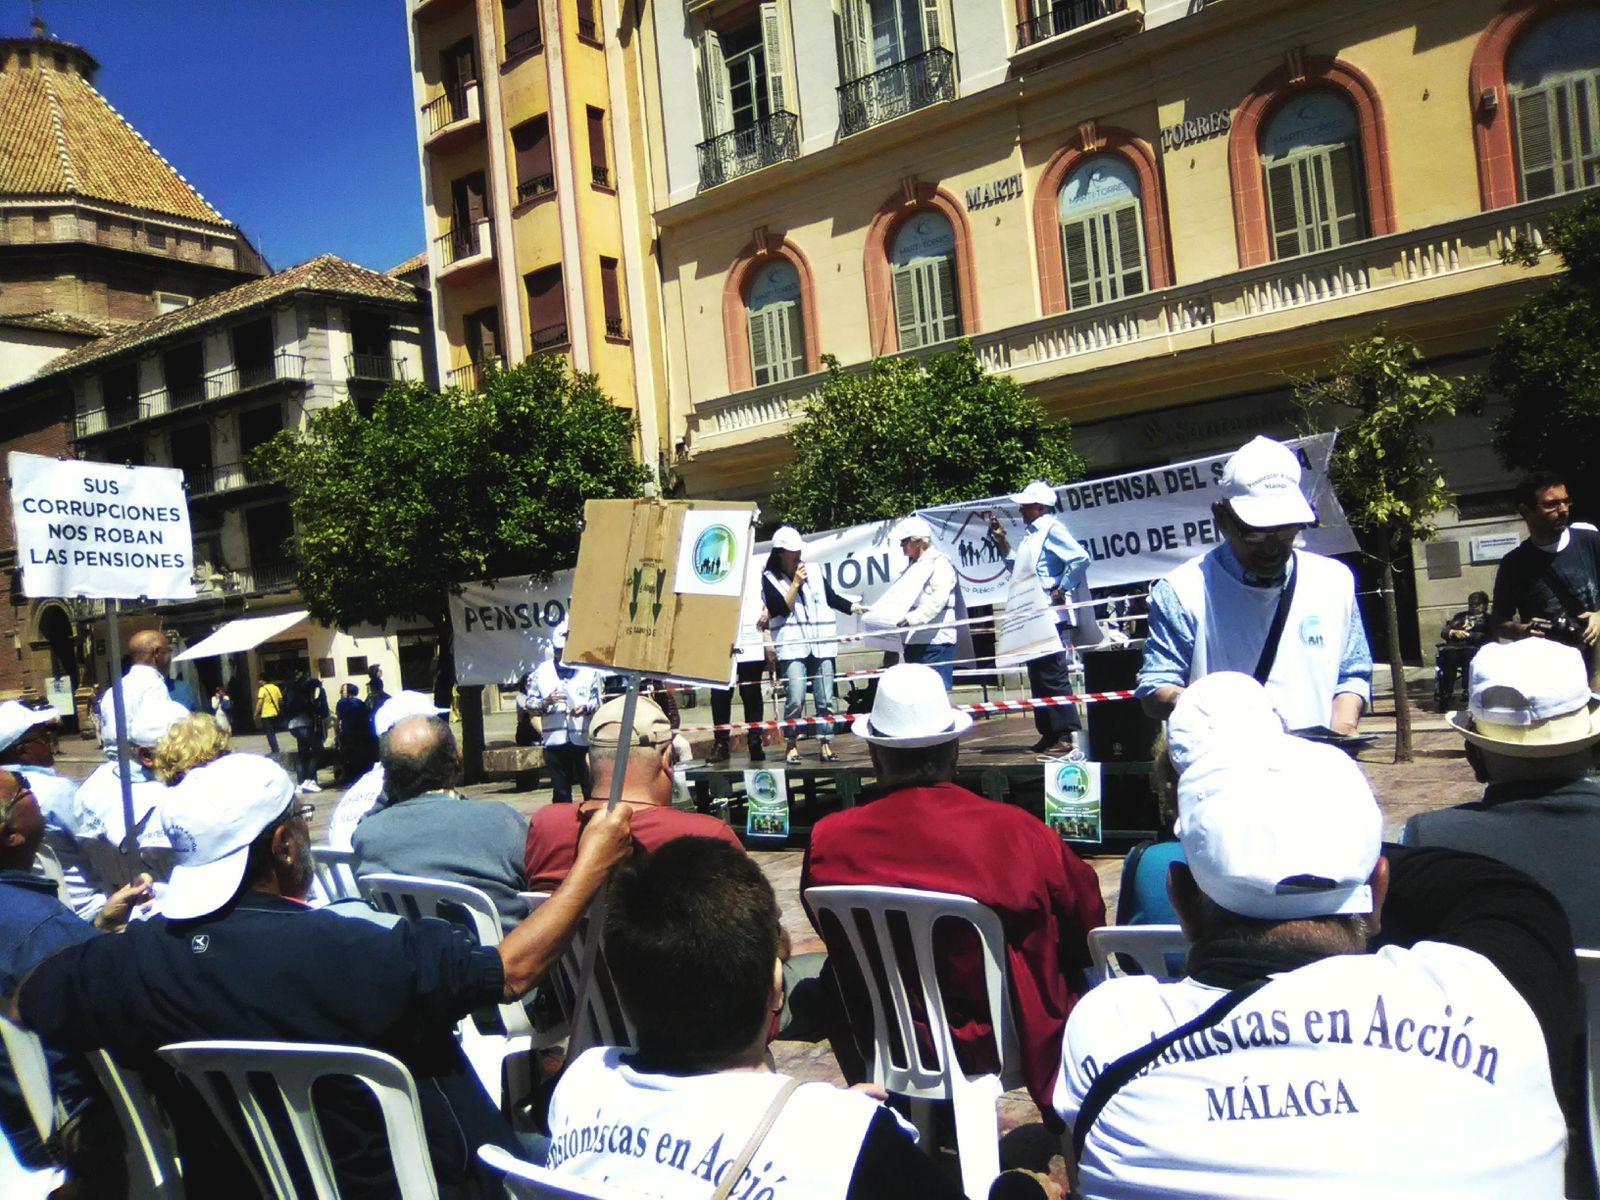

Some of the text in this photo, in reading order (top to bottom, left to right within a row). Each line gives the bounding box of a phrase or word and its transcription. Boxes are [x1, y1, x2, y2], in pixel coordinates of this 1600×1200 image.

[1161, 108, 1231, 148] TORRES
[83, 478, 120, 495] SUS
[1066, 473, 1161, 512] DEFENSA
[1163, 466, 1207, 494] DEL
[22, 498, 181, 522] CORRUPCIONES
[48, 523, 163, 545] NOS ROBAN
[1146, 525, 1178, 552] DE
[30, 549, 185, 568] LAS PENSIONES
[823, 551, 890, 590] IÓN
[464, 598, 571, 633] PENSIO
[1304, 1006, 1353, 1045] en
[1363, 994, 1500, 1086] Acción
[1205, 1075, 1360, 1122] MÁLAGA
[656, 1132, 693, 1172] en
